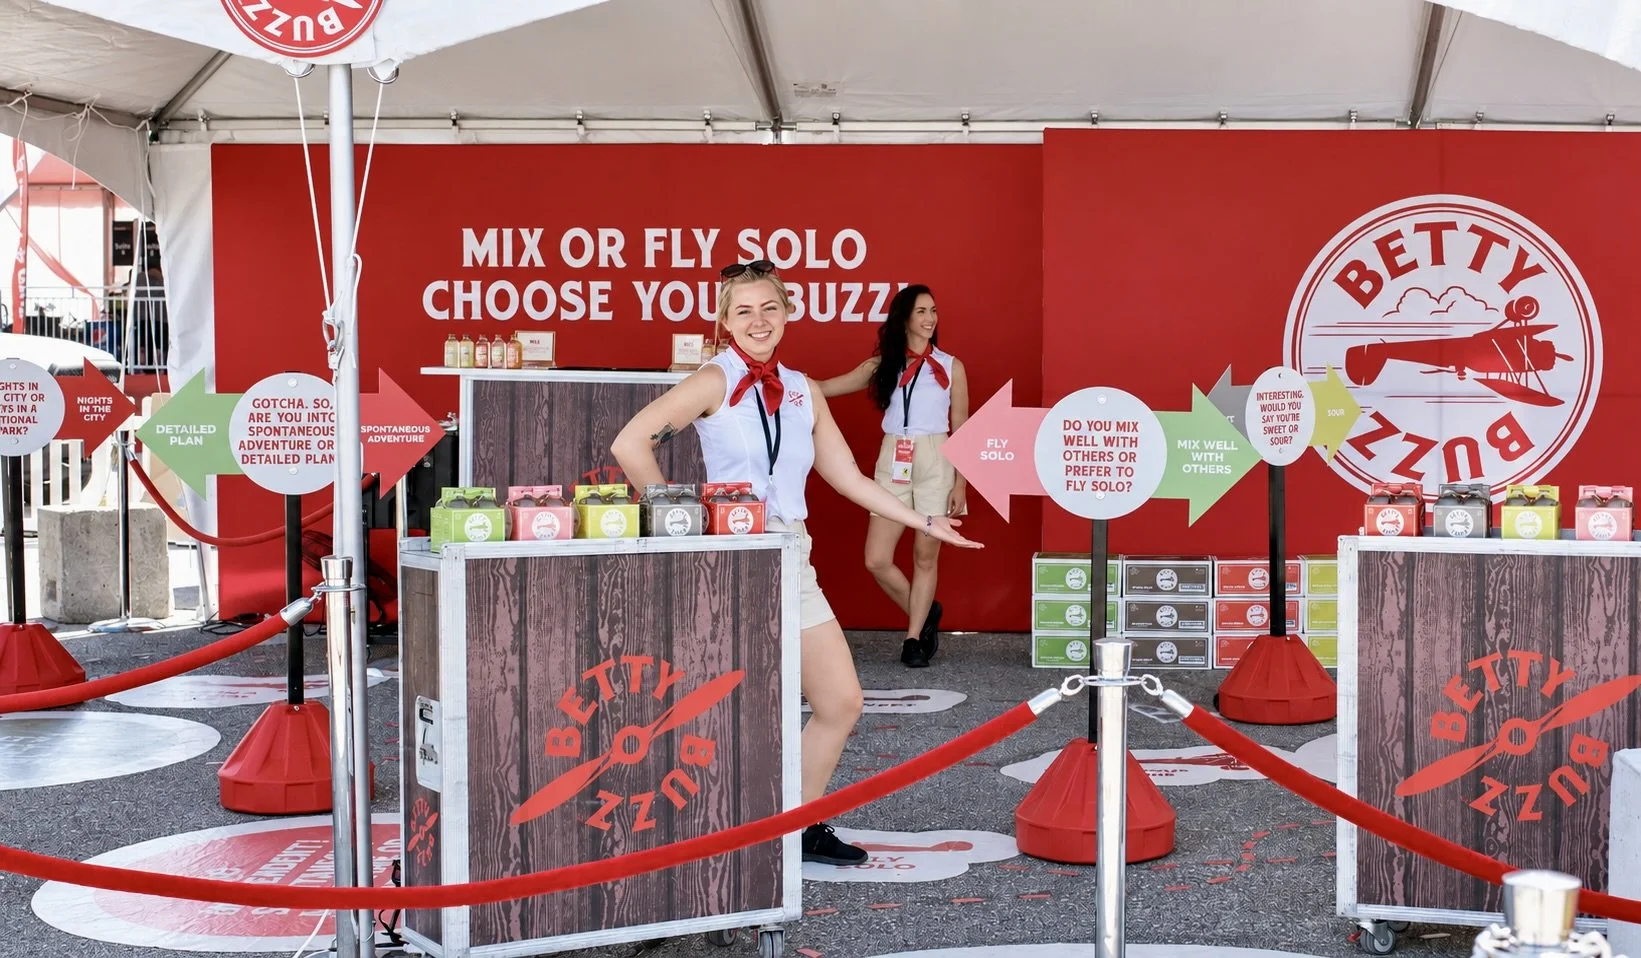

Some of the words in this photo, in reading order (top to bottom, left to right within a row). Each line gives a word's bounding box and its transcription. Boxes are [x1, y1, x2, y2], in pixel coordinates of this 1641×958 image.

[242, 0, 345, 41] BUZZ
[462, 227, 546, 267] MIX
[559, 228, 626, 269] OR
[644, 228, 720, 268] FLY
[737, 228, 867, 269] SOLO
[1332, 221, 1548, 310] BETTY
[423, 280, 613, 321] CHOOSE
[632, 281, 721, 322] YOU
[28, 382, 39, 391] IN
[3, 393, 27, 402] CITY
[30, 393, 45, 402] OR
[77, 396, 113, 405] NIGHTS
[17, 404, 28, 413] IN
[31, 404, 37, 413] A
[80, 405, 90, 413] IN
[92, 405, 111, 413] THE
[252, 398, 309, 409] GOTCHA.
[313, 398, 334, 410] SO,
[1260, 403, 1286, 413] WOULD
[1288, 402, 1302, 411] YOU
[83, 414, 106, 422] CITY
[248, 412, 272, 423] ARE
[277, 412, 302, 423] YOU
[1327, 408, 1345, 417] SOUR
[1262, 414, 1275, 424] SAY
[156, 424, 216, 434] DETAILED
[248, 426, 335, 437] SPONTANEOUS
[1063, 420, 1082, 431] DO
[1086, 420, 1112, 432] YOU
[1116, 421, 1139, 433] MIX
[1263, 425, 1287, 435] SWEET
[1288, 424, 1299, 433] OR
[169, 436, 203, 446] PLAN
[367, 435, 425, 443] ADVENTURE
[987, 439, 1008, 449] FLY
[1063, 435, 1098, 447] WELL
[1103, 436, 1138, 448] WITH
[1270, 436, 1293, 446] SOUR?
[238, 440, 312, 451] ADVENTURE
[317, 440, 335, 451] OR
[1177, 440, 1200, 450] MIX
[1203, 440, 1238, 450] WELL
[1345, 411, 1535, 483] BUZZ
[241, 454, 301, 465] DETAILED
[980, 451, 1015, 461] SOLO
[1063, 450, 1114, 462] OTHERS
[1118, 451, 1137, 463] OR
[1191, 452, 1224, 462] WITH
[1065, 465, 1111, 477] PREFER
[1116, 466, 1134, 478] TO
[1182, 464, 1232, 474] OTHERS
[1066, 480, 1087, 492] FLY
[1091, 481, 1132, 493] SOLO?
[1430, 649, 1577, 743] BETTY
[545, 656, 686, 758] BETTY
[1468, 732, 1609, 822] BUZZ
[585, 734, 717, 832] BUZZ
